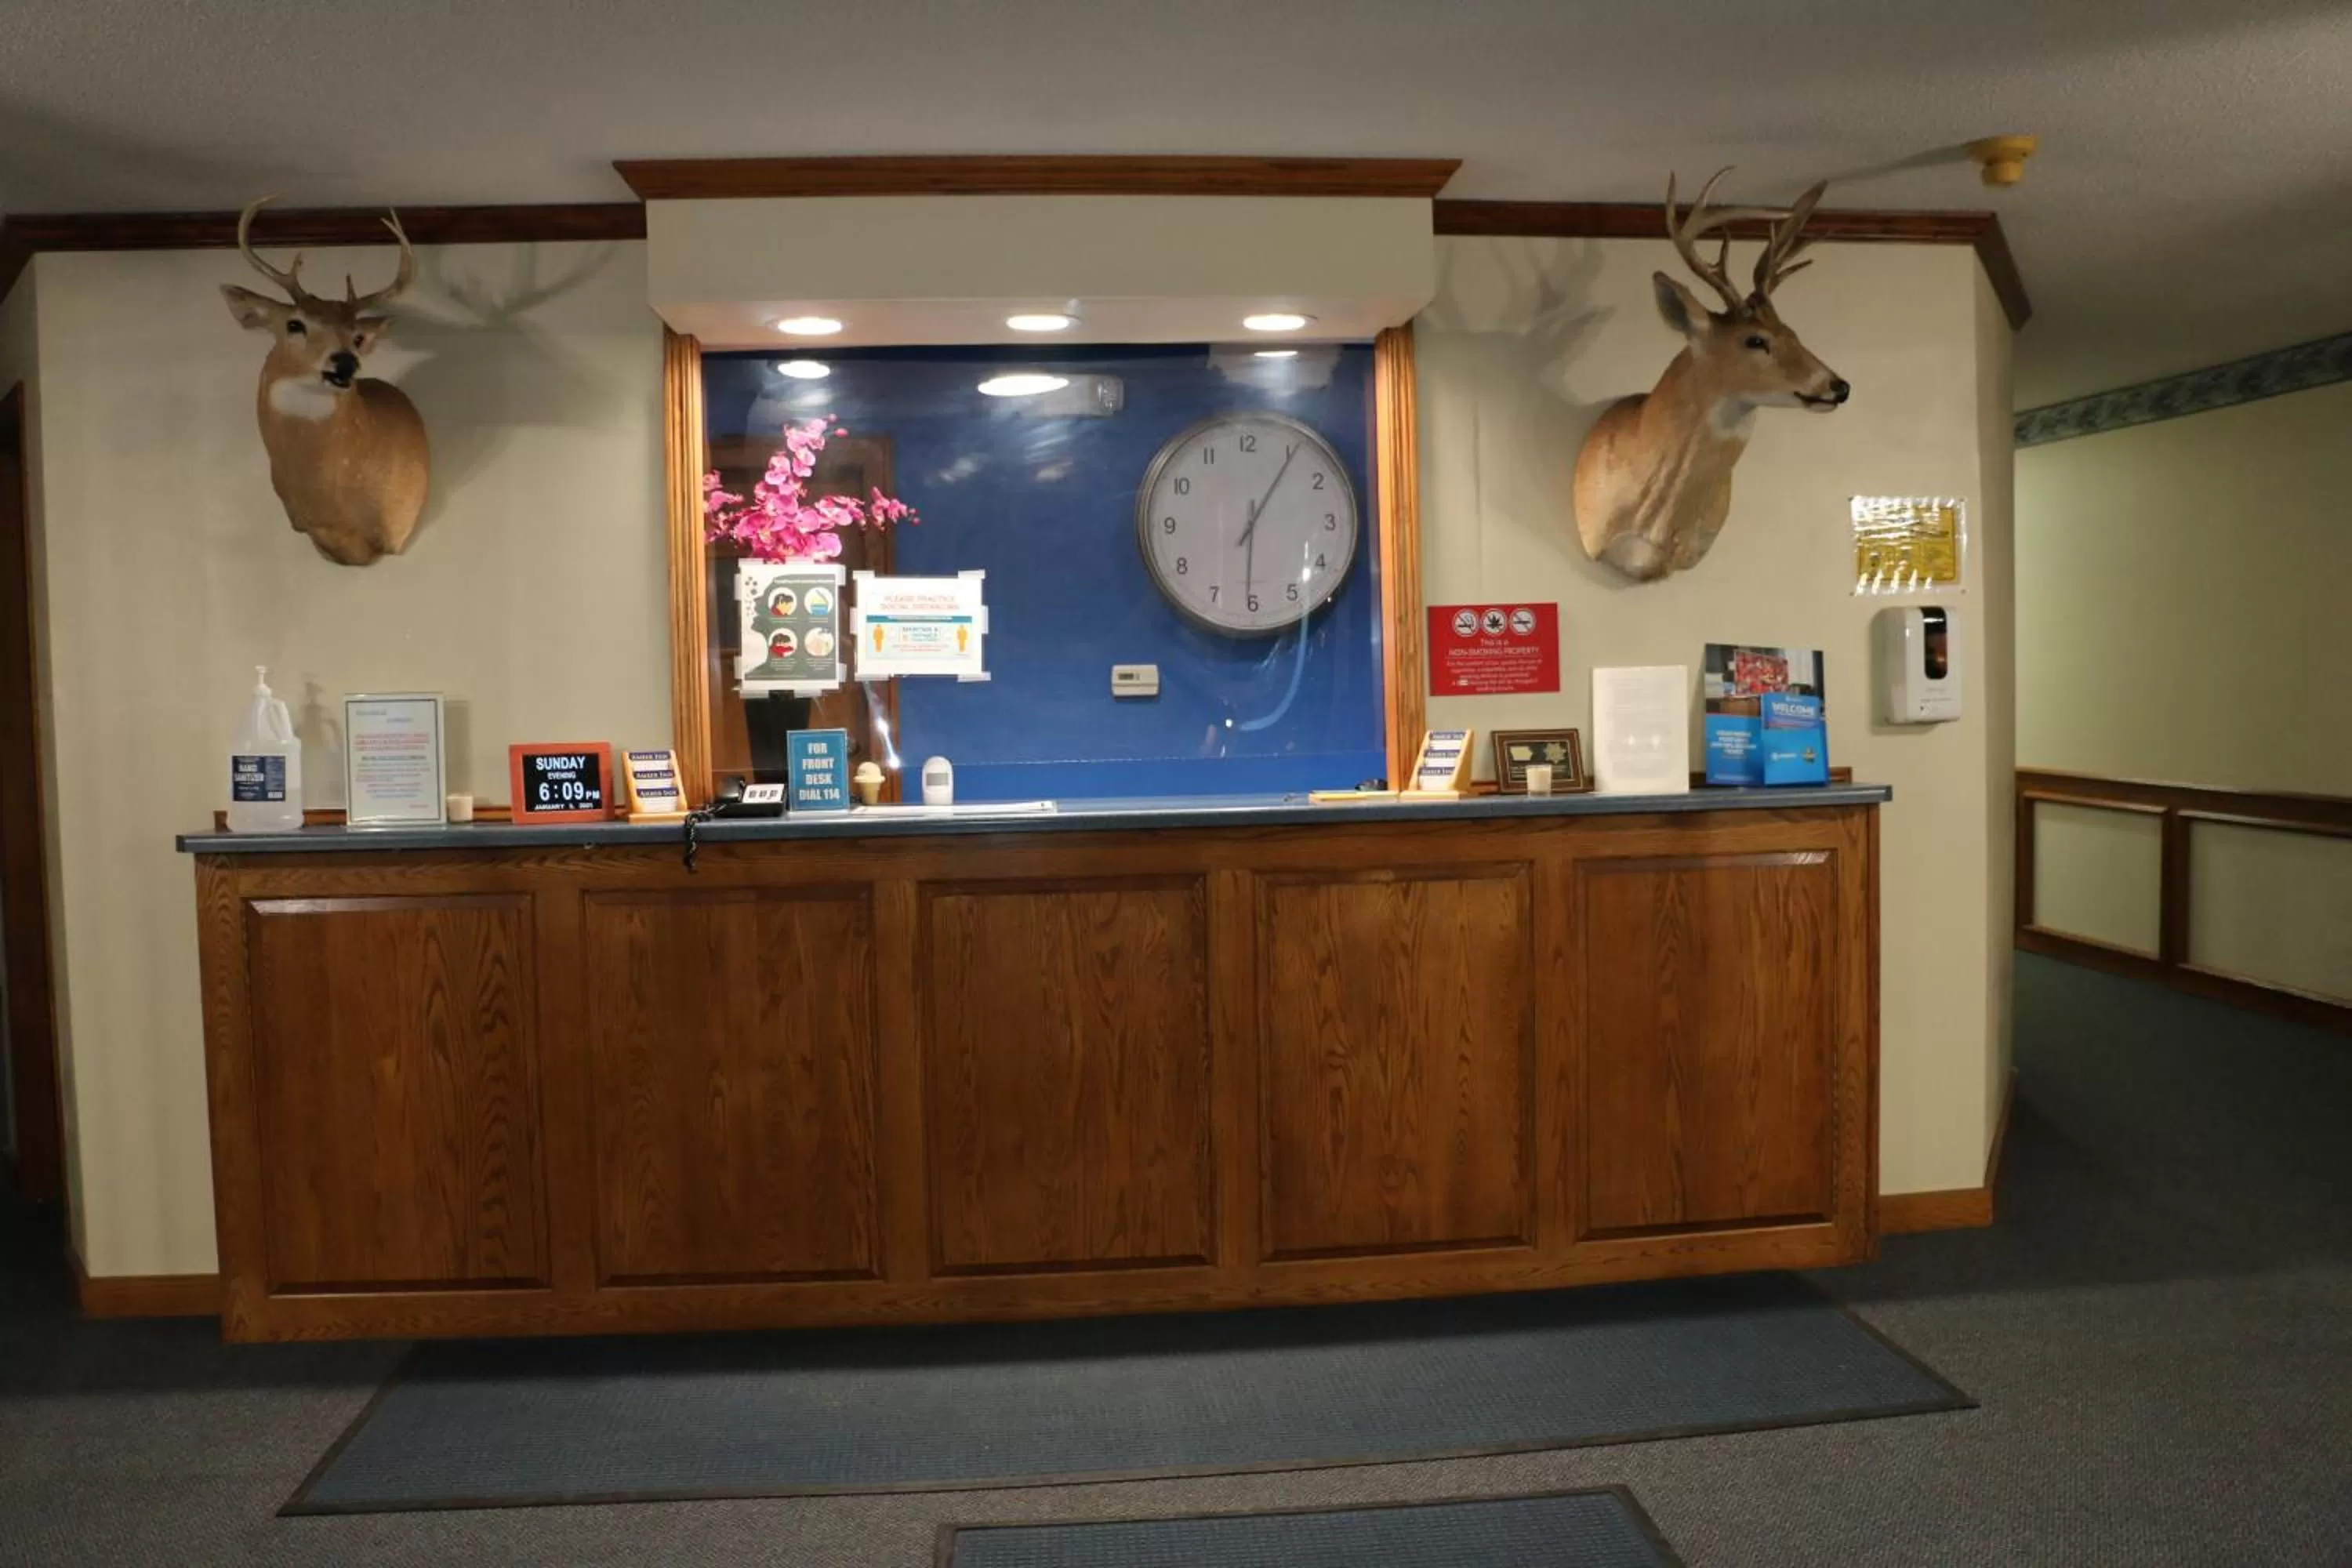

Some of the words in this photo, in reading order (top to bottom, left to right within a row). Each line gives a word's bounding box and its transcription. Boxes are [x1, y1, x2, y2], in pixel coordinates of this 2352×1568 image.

[1240, 435, 1257, 452] 12
[1203, 448, 1214, 464] 11
[1174, 477, 1190, 495] 10
[1312, 473, 1324, 490] 2
[1164, 517, 1176, 534] 9
[1325, 514, 1336, 531] 3
[1177, 557, 1188, 575] 8
[1314, 553, 1326, 570] 4
[1209, 586, 1220, 602] 7
[1286, 583, 1298, 601] 5
[1247, 595, 1258, 612] 6
[1772, 702, 1814, 717] WELCOME
[808, 742, 827, 754] FOR
[535, 756, 586, 771] SUNDAY
[802, 757, 834, 770] FRONT
[547, 771, 576, 780] EVENING
[805, 773, 833, 785] DESK
[586, 790, 600, 800] PM
[799, 789, 821, 800] DIAL
